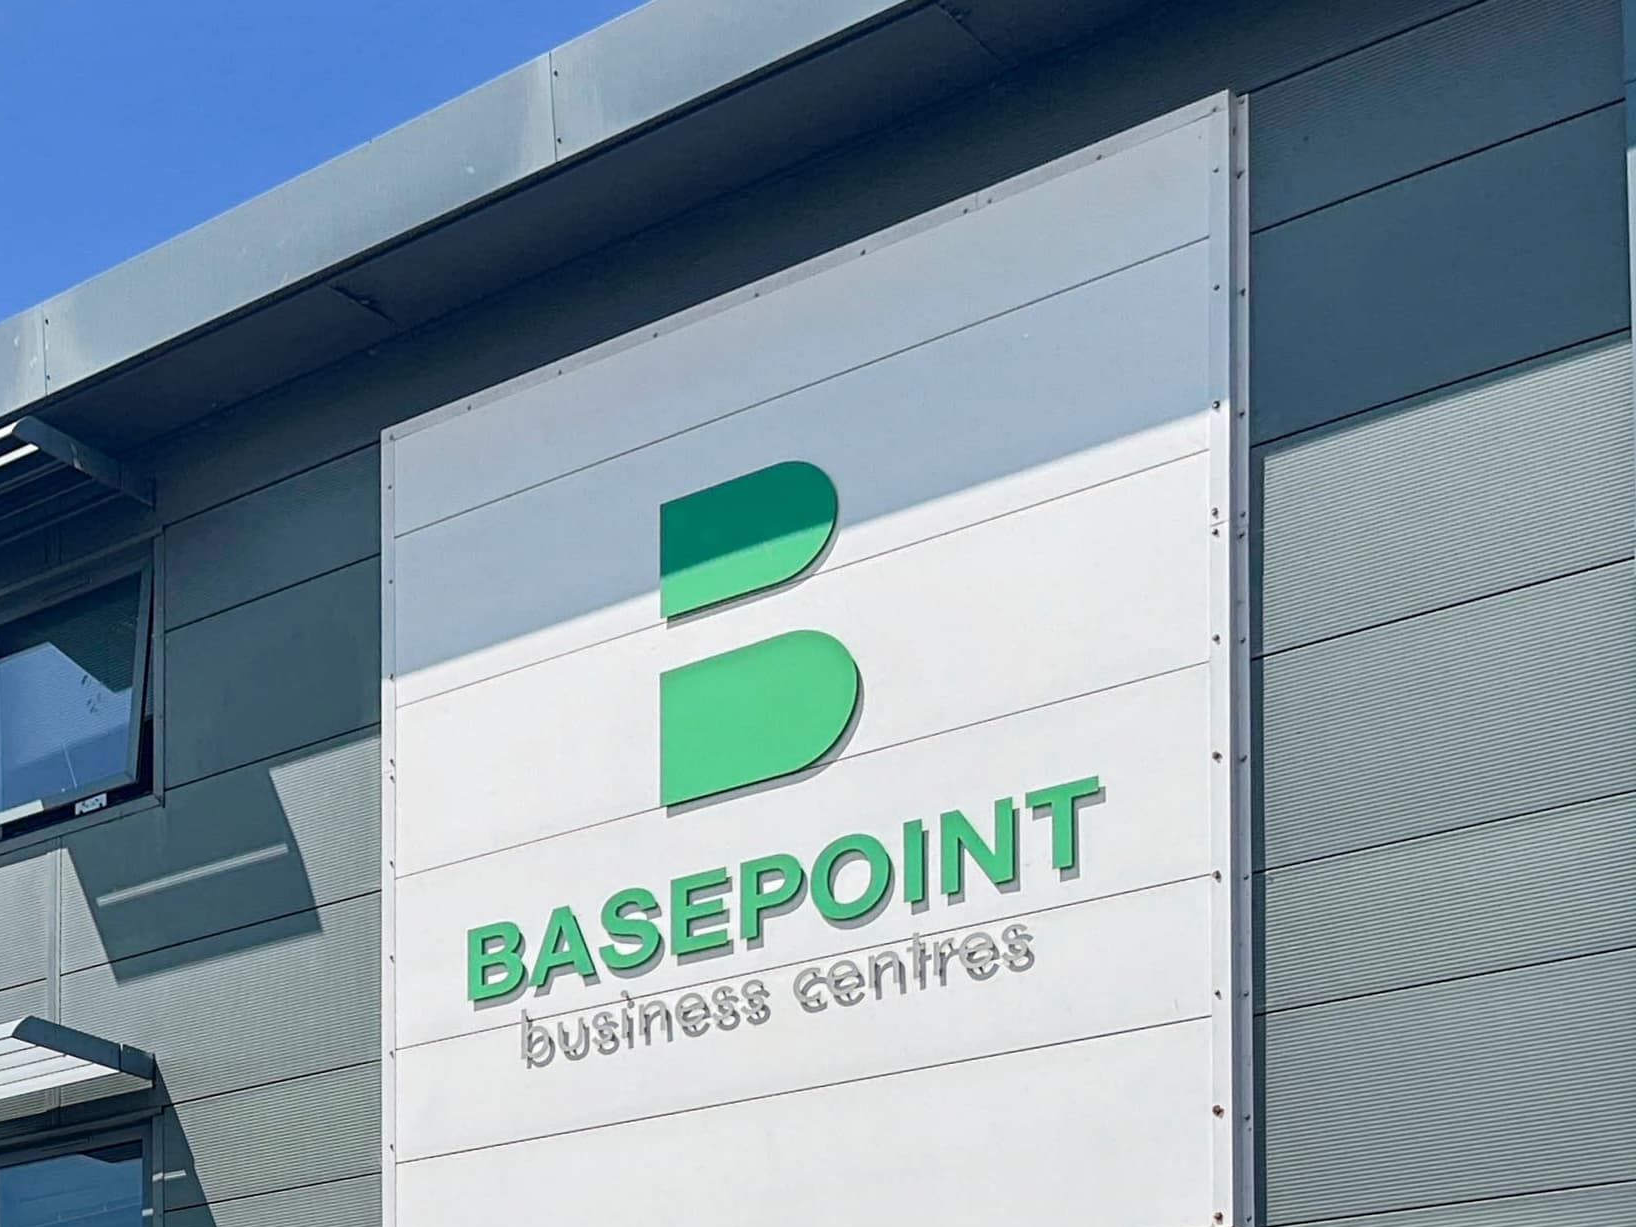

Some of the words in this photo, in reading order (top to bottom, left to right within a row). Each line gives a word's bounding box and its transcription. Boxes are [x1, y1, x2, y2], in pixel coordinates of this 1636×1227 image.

[467, 775, 1101, 1002] BASEPOINT
[520, 978, 769, 1063] business
[793, 921, 1033, 1006] centres
